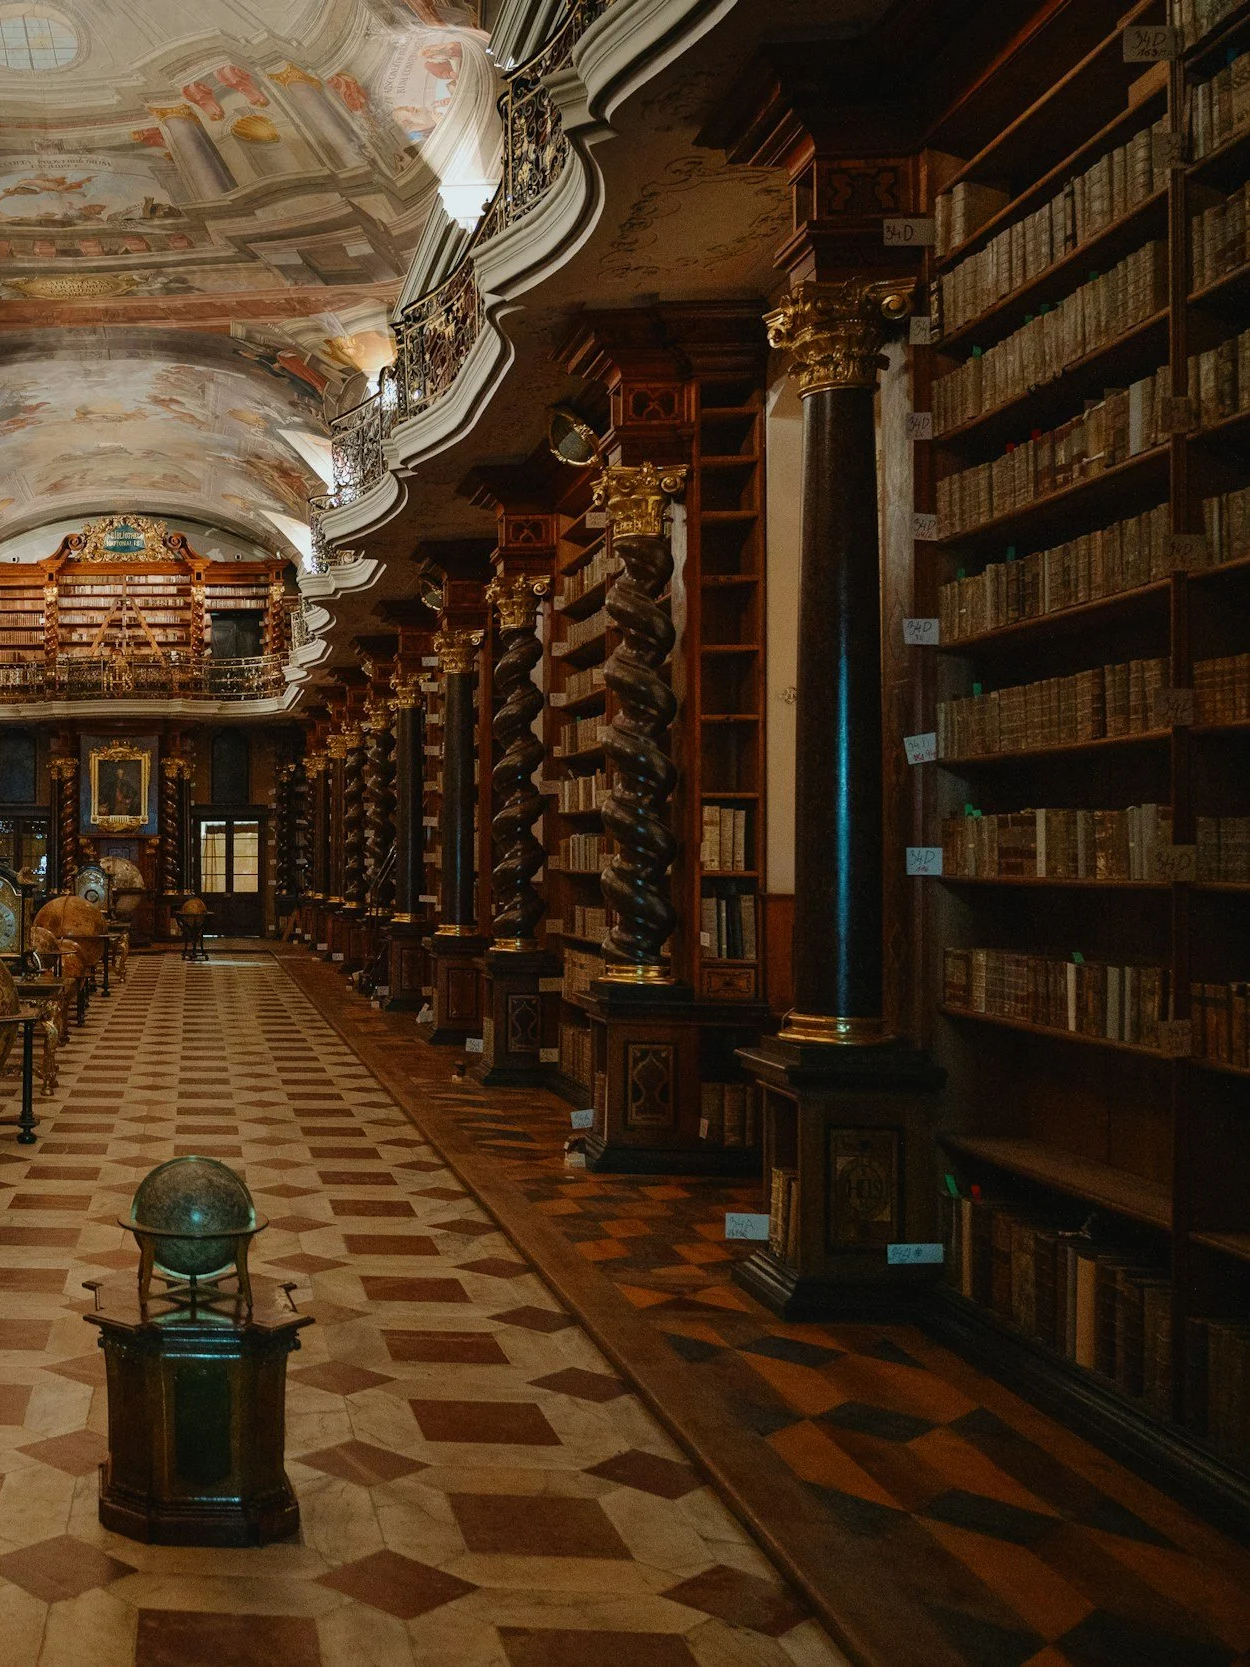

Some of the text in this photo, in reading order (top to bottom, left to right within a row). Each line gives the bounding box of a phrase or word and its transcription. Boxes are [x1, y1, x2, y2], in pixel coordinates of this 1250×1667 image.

[885, 225, 914, 241] 34D
[907, 620, 933, 636] 34D
[909, 849, 936, 867] 34D
